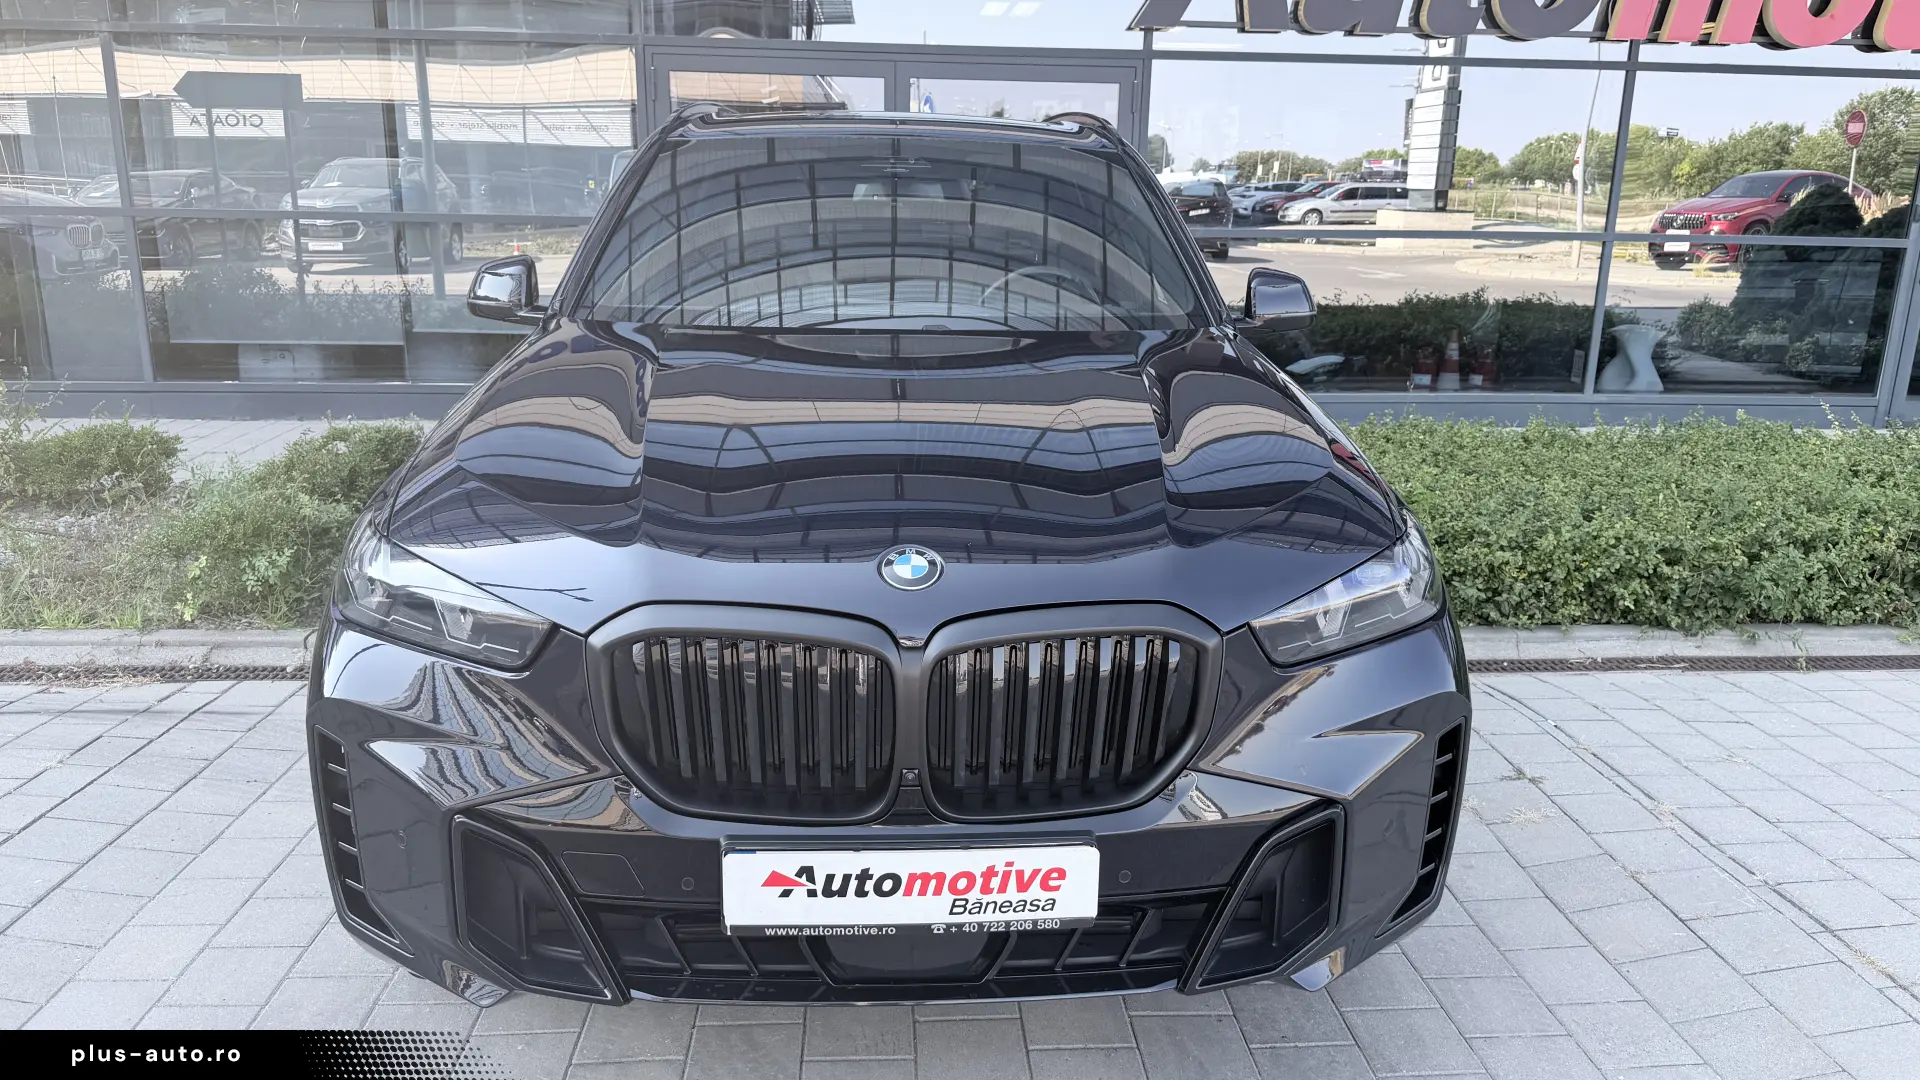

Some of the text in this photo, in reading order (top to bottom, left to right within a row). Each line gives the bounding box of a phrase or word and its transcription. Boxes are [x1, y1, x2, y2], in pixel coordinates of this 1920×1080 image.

[887, 547, 935, 561] BMW
[777, 861, 1067, 898] Automotive
[948, 897, 1057, 916] Băneasa
[764, 925, 896, 936] www.automotive.ro
[962, 923, 978, 933] 40
[982, 922, 1006, 932] 722
[1010, 920, 1033, 931] 206
[1037, 919, 1060, 929] 580
